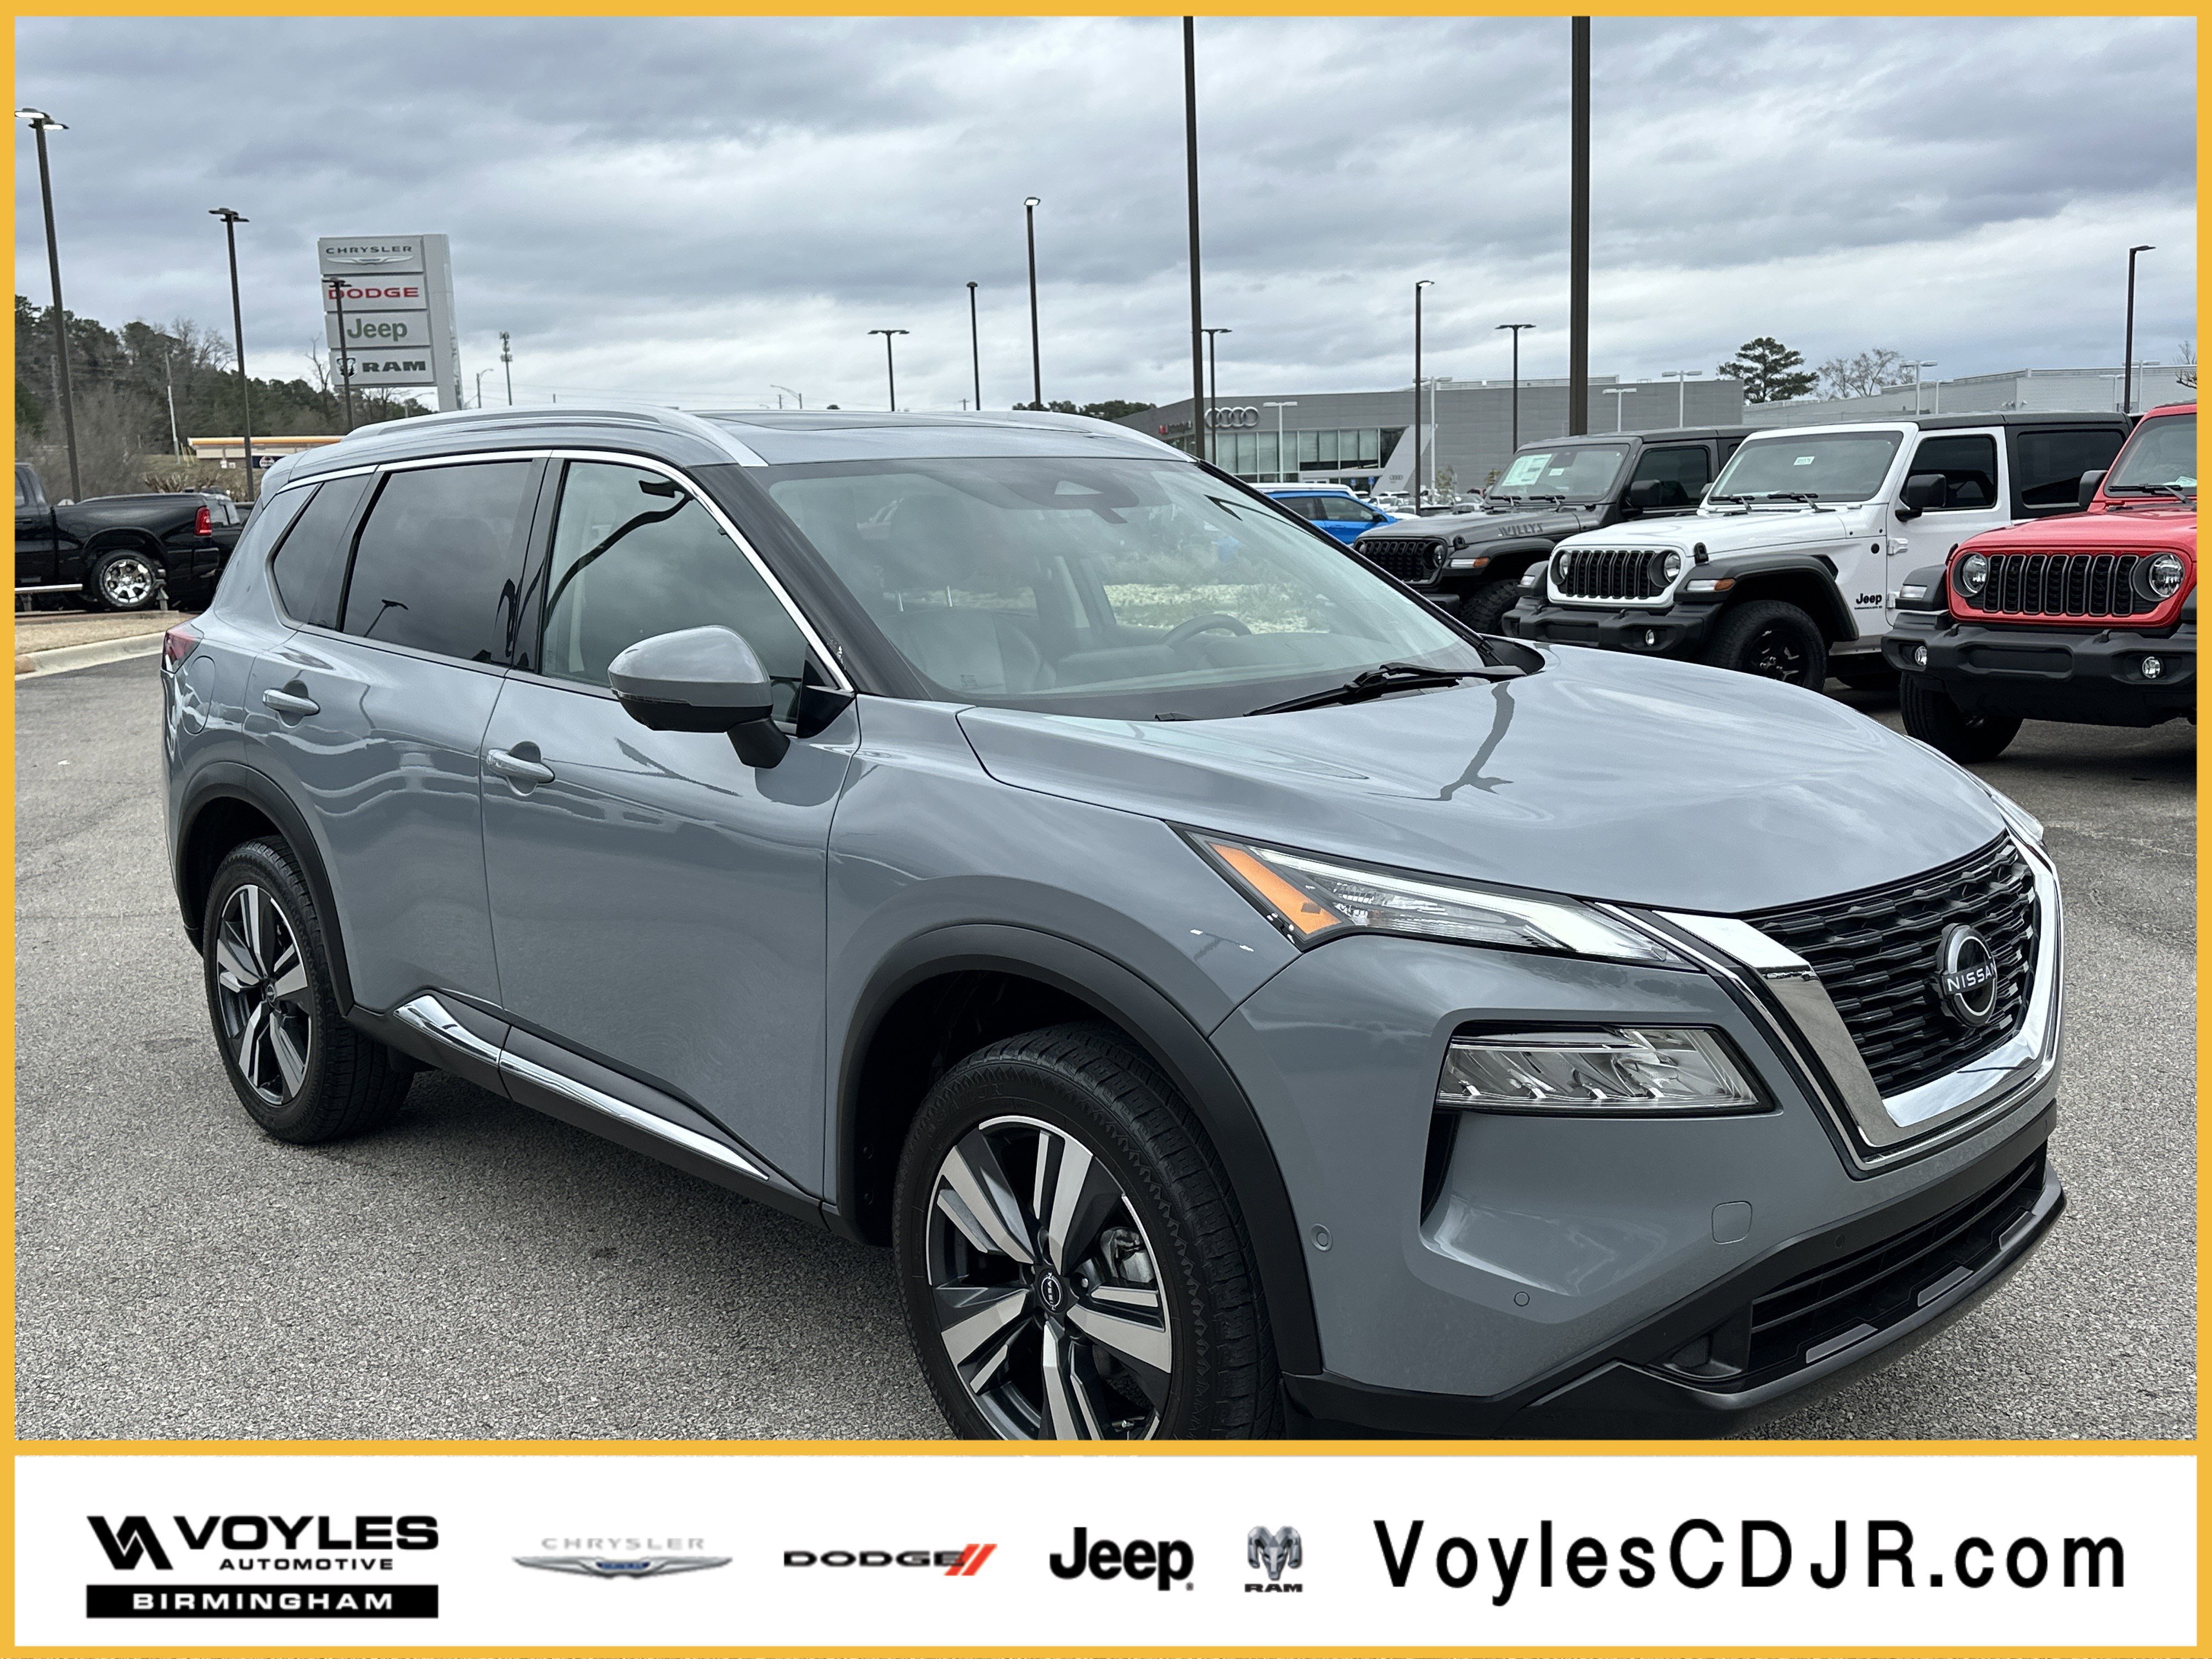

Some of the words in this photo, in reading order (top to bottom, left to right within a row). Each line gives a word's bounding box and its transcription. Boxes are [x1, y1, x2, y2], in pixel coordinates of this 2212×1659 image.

[325, 246, 413, 254] CHRYSLER
[328, 287, 419, 300] DODGE
[347, 318, 408, 341] Jeep
[362, 360, 426, 373] RAM
[1498, 523, 1543, 537] WILLYS
[1855, 592, 1882, 605] Jeep
[1947, 962, 1997, 991] NISSAN
